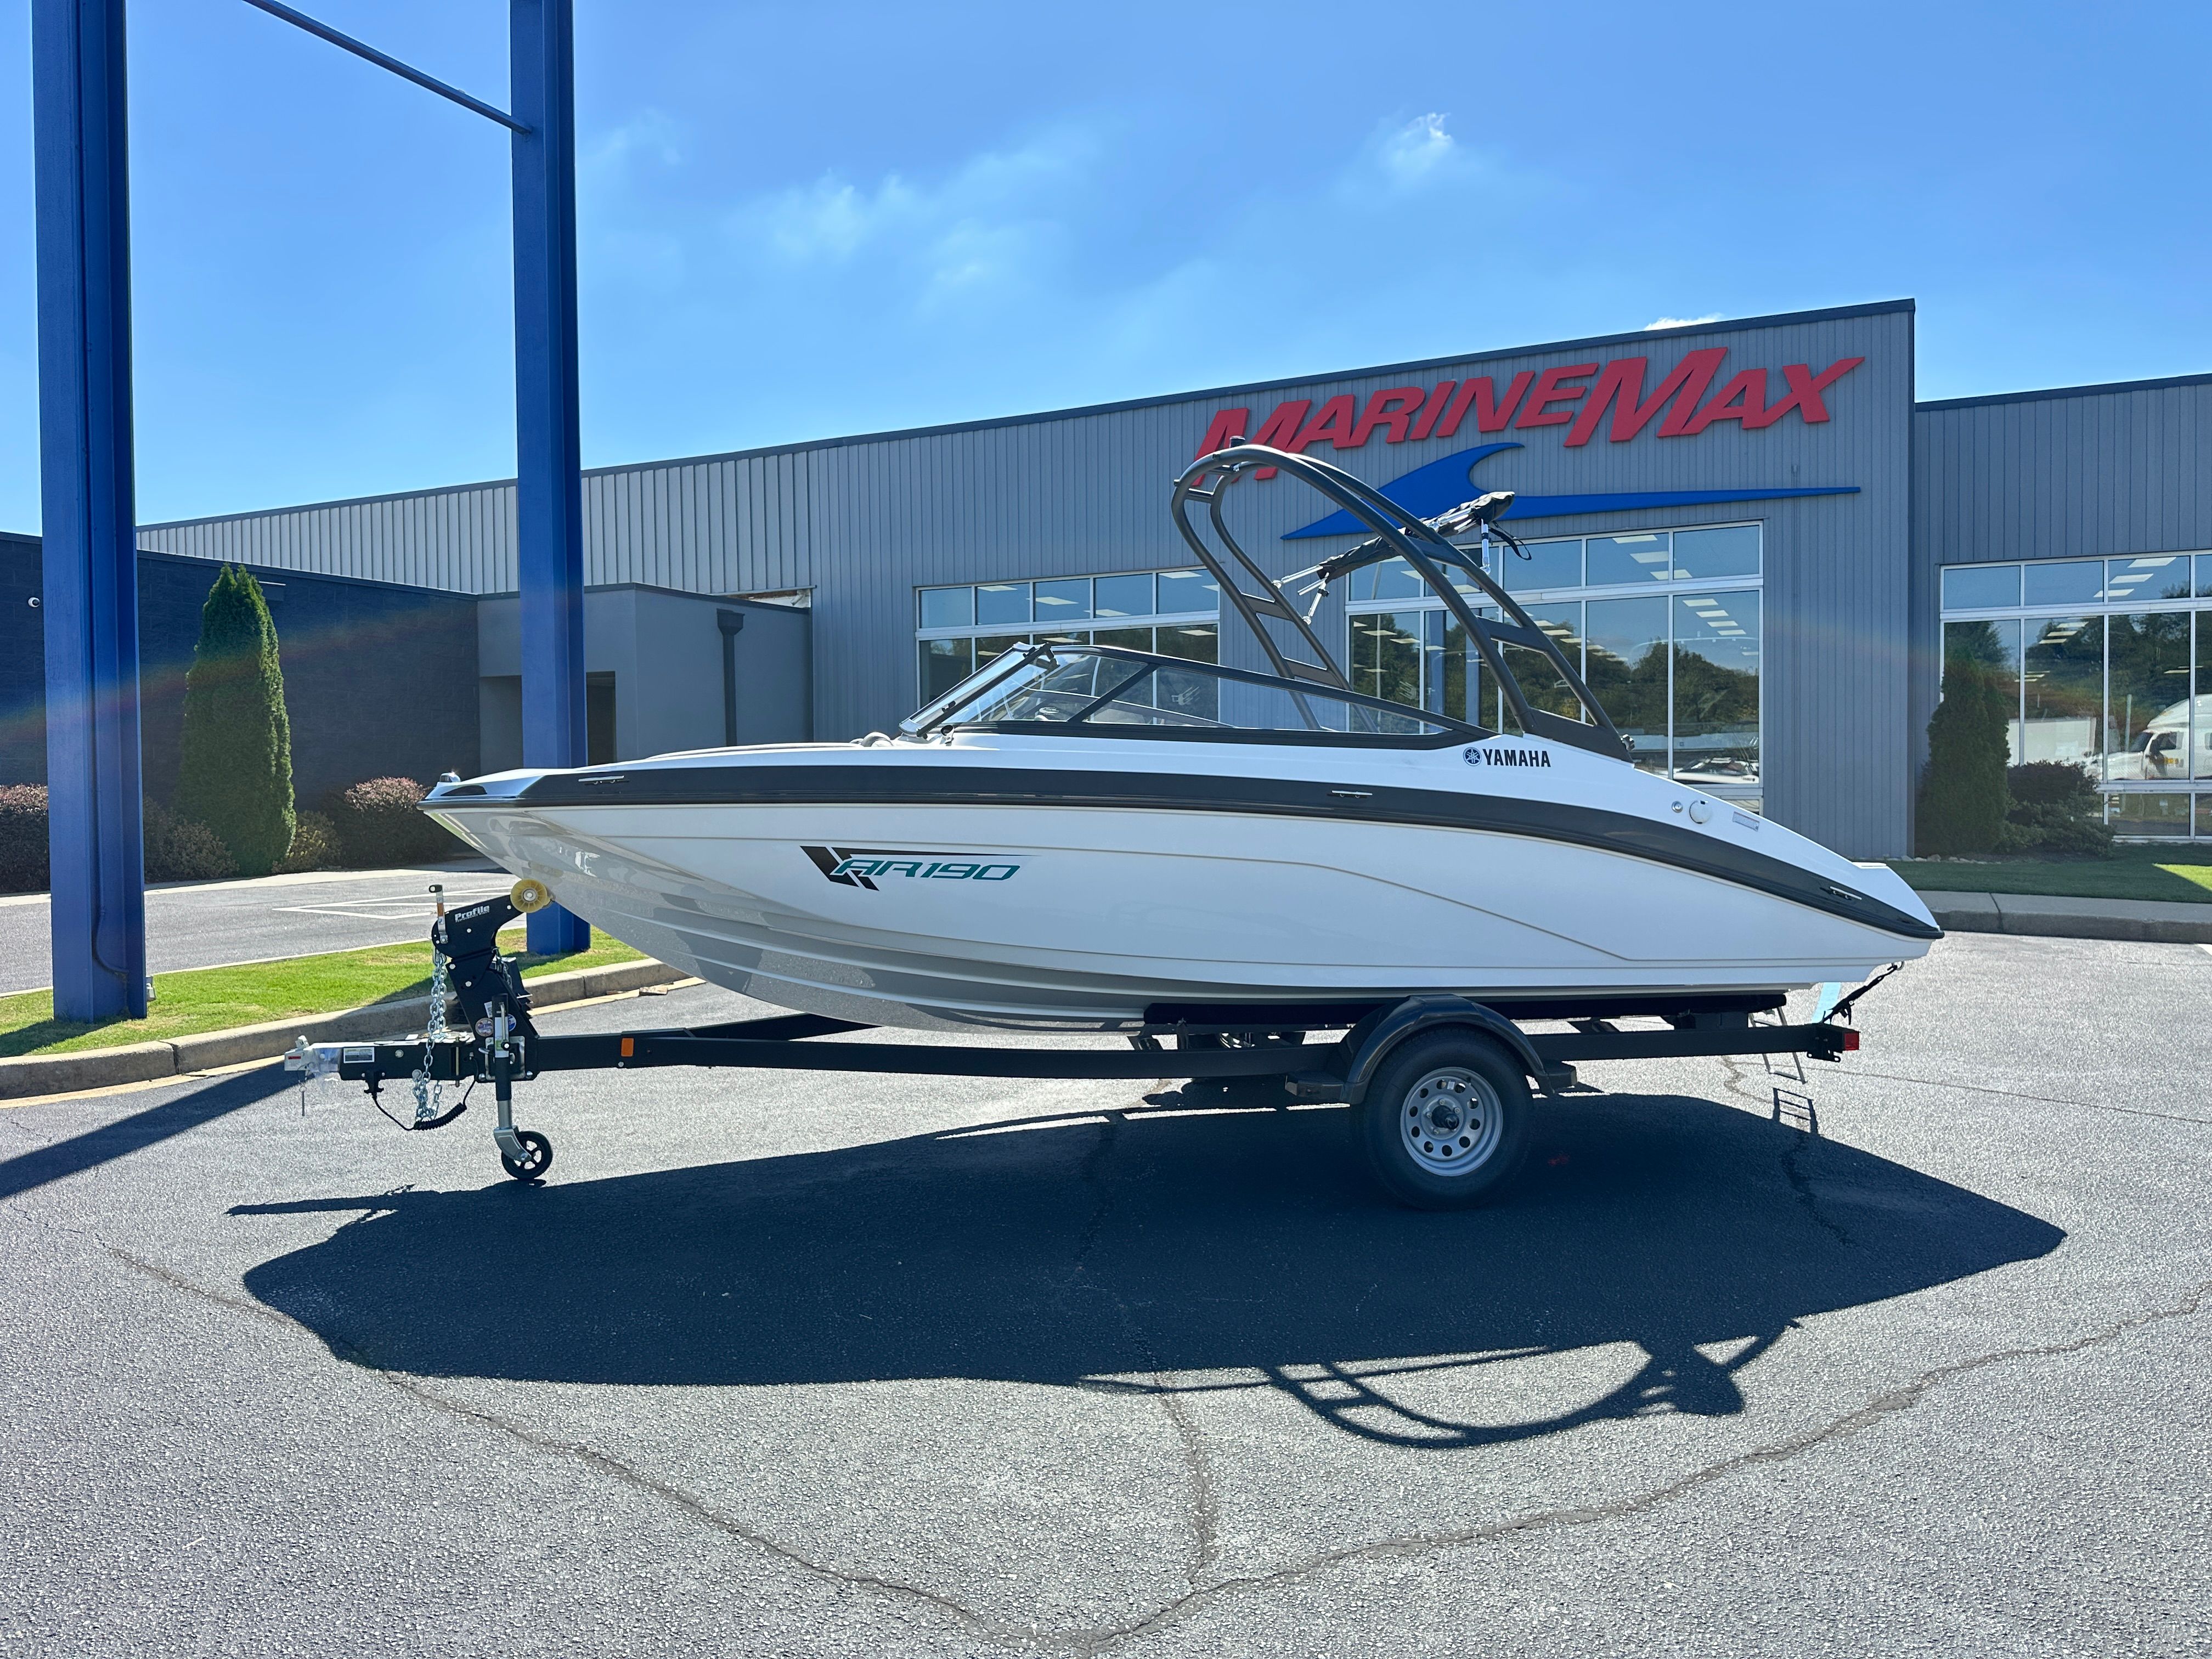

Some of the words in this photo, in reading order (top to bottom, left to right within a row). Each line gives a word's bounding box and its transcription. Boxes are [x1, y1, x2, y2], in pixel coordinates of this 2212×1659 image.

[1482, 749, 1551, 767] YAMAHA
[833, 859, 1021, 881] AR190
[455, 905, 490, 921] Profile
